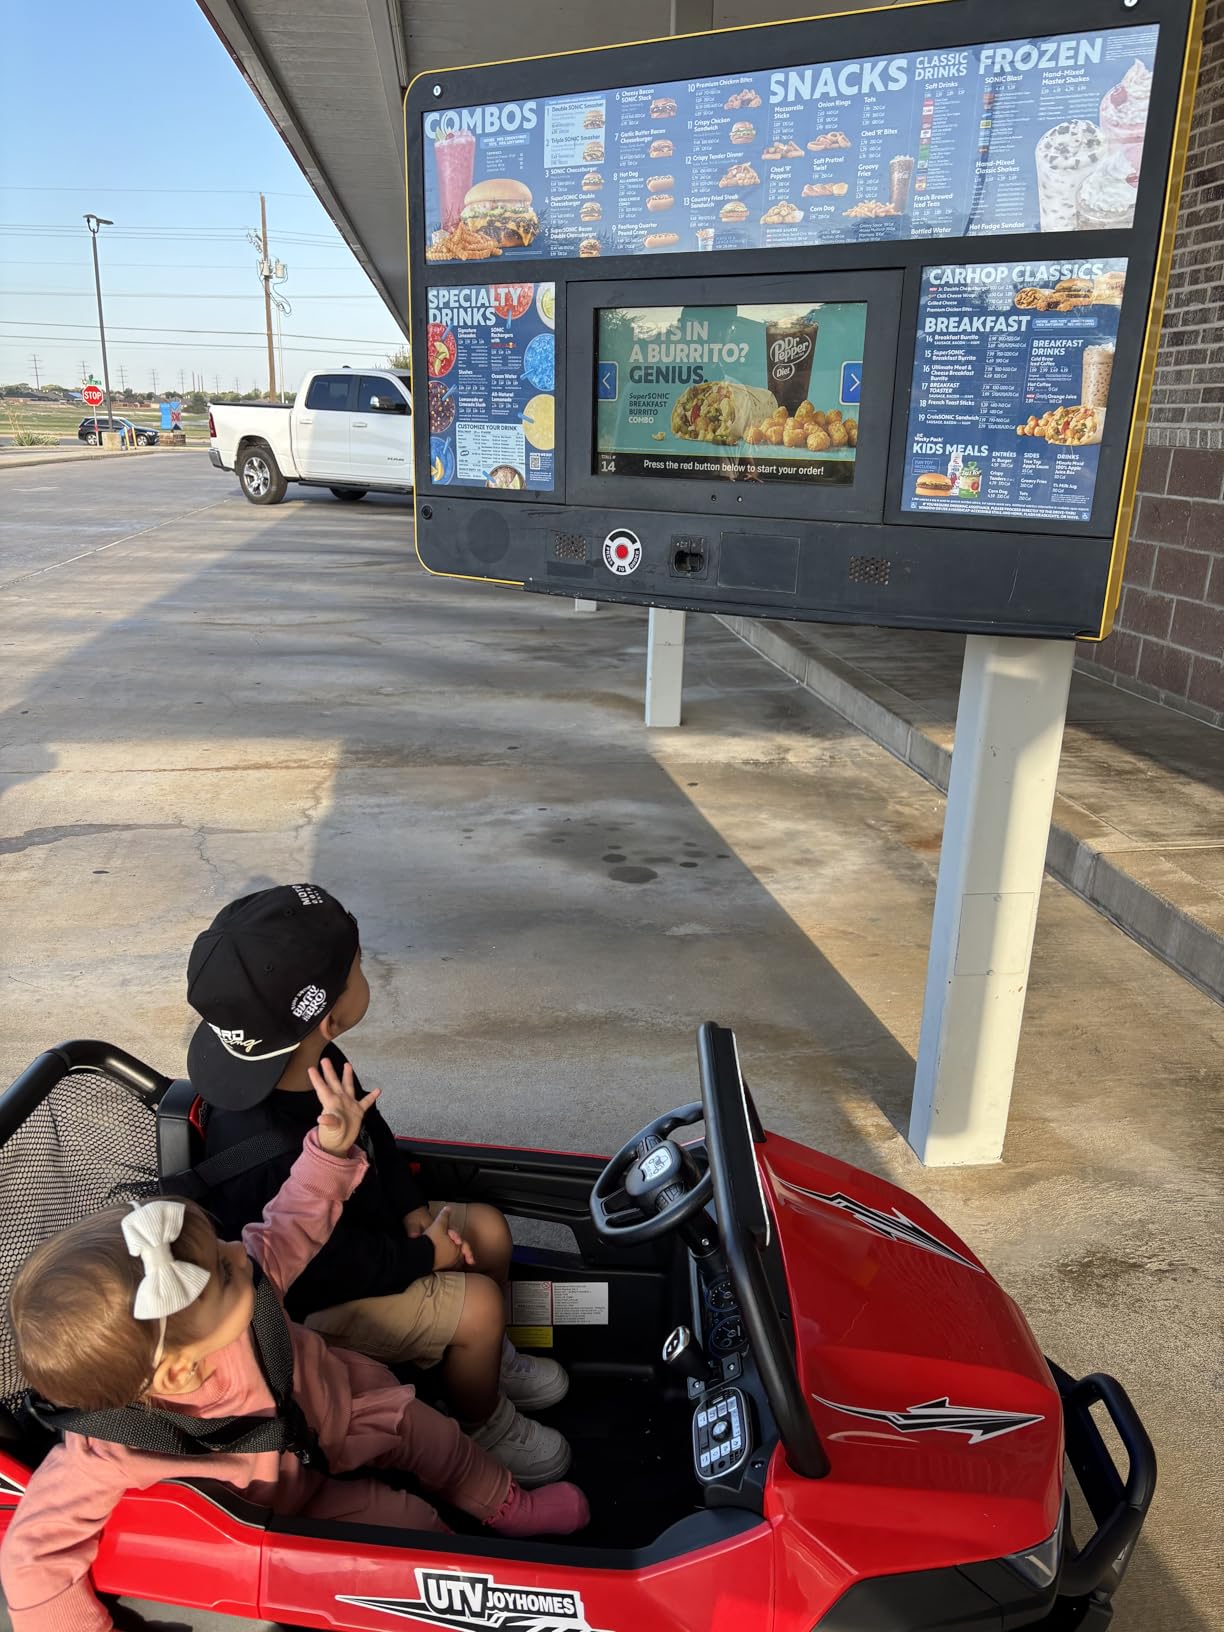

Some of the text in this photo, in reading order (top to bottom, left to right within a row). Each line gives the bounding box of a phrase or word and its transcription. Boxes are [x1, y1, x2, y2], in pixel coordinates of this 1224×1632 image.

[916, 52, 968, 68] CLASSIC
[979, 38, 1103, 75] FROZEN
[915, 64, 967, 80] DRINKS
[1043, 69, 1084, 78] Hand-Mixed
[769, 58, 907, 103] SNACKS
[985, 76, 1005, 84] SONIC
[687, 83, 695, 92] 10
[424, 101, 538, 139] COMBOS
[685, 156, 691, 164] 12
[976, 160, 1015, 168] Hand-Mixed
[545, 169, 549, 178] 3
[613, 172, 617, 180] 8
[929, 263, 1104, 284] CARHOP CLASSICS
[428, 287, 521, 308] SPECIALTY
[429, 308, 496, 326] DRINKS
[925, 315, 1031, 333] BREAKFAST
[632, 321, 709, 341] TTS IN
[784, 336, 800, 350] Dr
[1033, 339, 1084, 347] BREAKFAST
[629, 342, 749, 363] A BURRITO?
[774, 340, 809, 363] Pepper
[629, 365, 708, 384] GENIUS.
[776, 367, 790, 377] Diet
[922, 382, 928, 390] 17
[85, 391, 101, 400] STOP
[629, 392, 670, 400] SuperSONIC
[629, 408, 658, 416] BURRITO
[628, 416, 654, 424] COMBO
[913, 443, 989, 456] KIDS MEALS
[601, 461, 616, 472] 14
[644, 460, 664, 469] Press
[666, 461, 678, 469] the
[680, 461, 693, 470] red
[694, 462, 720, 471] button
[722, 463, 745, 472] below
[757, 465, 776, 474] start
[778, 466, 797, 475] your
[798, 466, 824, 475] order!
[606, 546, 614, 565] PRESS
[630, 550, 640, 568] ORDER
[427, 1578, 575, 1615] UTV JOYHOMES
